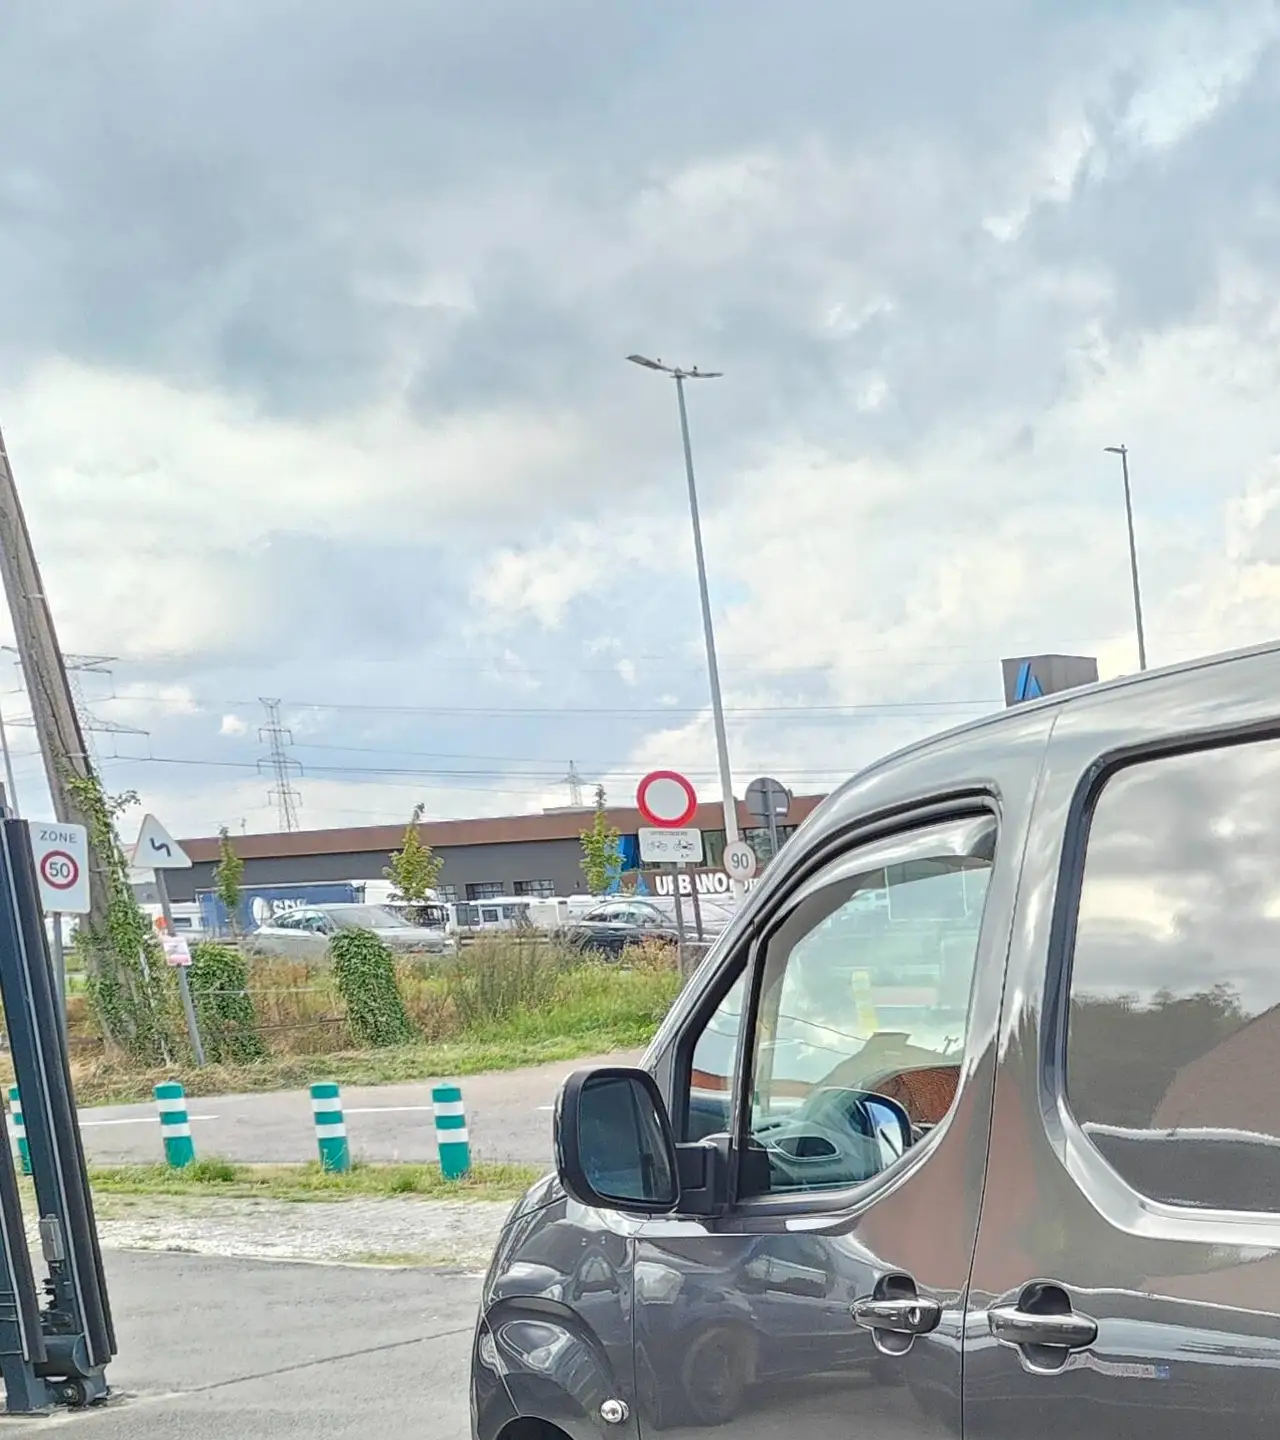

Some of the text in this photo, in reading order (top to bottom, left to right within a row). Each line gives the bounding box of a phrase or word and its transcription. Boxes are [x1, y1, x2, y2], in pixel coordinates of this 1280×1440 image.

[40, 830, 77, 844] ZONE
[731, 853, 749, 870] 90
[49, 862, 70, 879] 50
